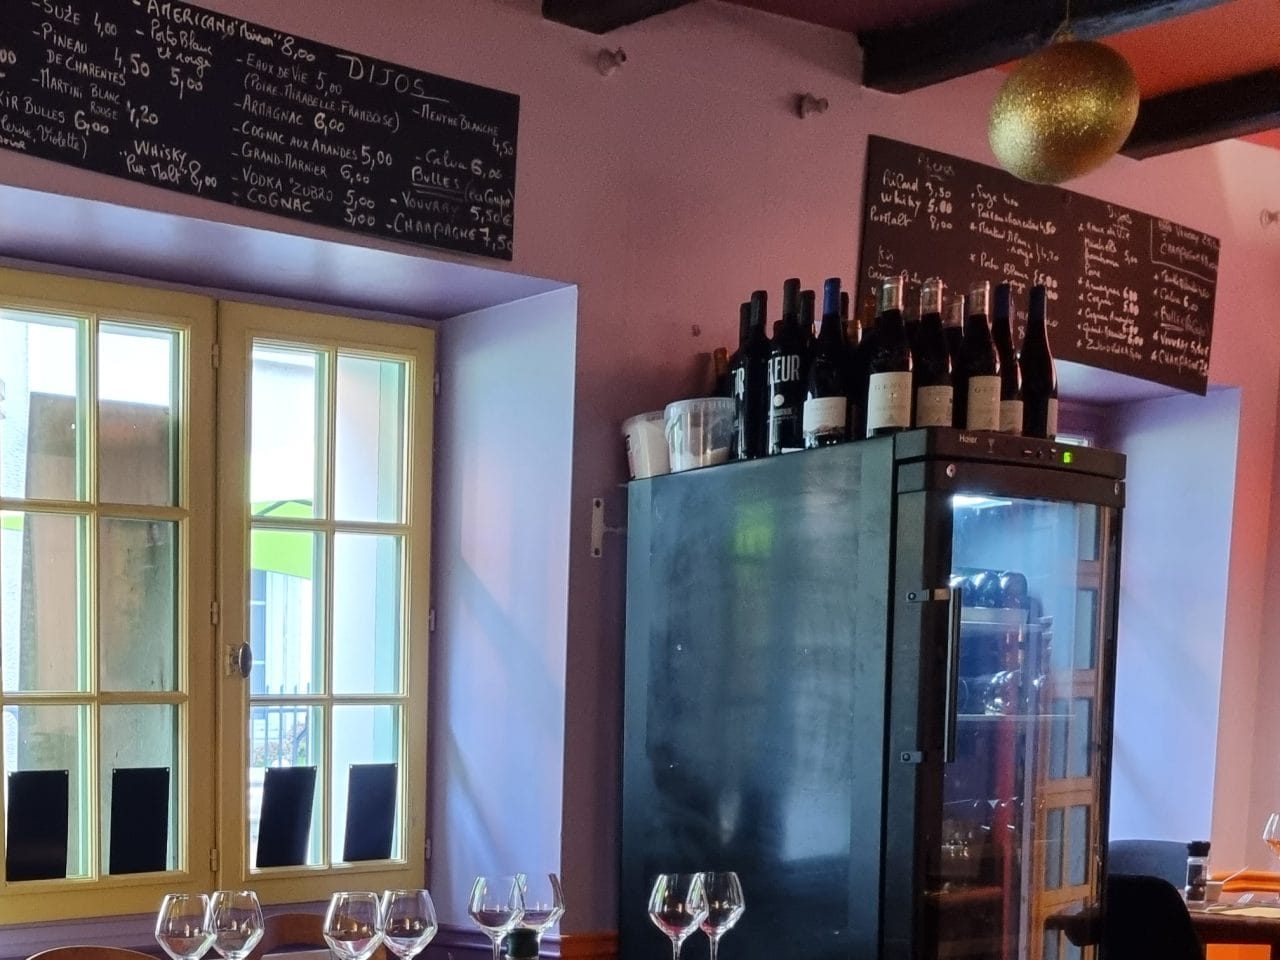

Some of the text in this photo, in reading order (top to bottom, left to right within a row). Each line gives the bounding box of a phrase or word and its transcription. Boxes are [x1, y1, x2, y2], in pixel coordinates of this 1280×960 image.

[280, 36, 316, 63] 8,00
[46, 49, 63, 65] DE
[64, 56, 126, 87] CHARENTES
[169, 65, 203, 100] 5,00
[246, 52, 274, 76] EAUX
[278, 66, 290, 80] DE
[316, 71, 343, 98] 5,00
[90, 82, 121, 106] BLANC
[23, 96, 66, 125] BULLES
[74, 109, 110, 136] 6,00
[242, 94, 345, 136] ARMAGNAC 6,00
[421, 103, 459, 126] MENTHE
[459, 113, 500, 137] BLANCHE
[241, 120, 285, 146] COGNAC
[311, 137, 358, 161] AMANDES
[360, 145, 393, 172] 5,00
[188, 160, 217, 193] 8,00
[242, 164, 375, 210] VODKA 5,00
[339, 164, 370, 185] 6,00
[246, 187, 376, 226] COGNAC 5,00
[394, 211, 478, 240] CHAMPAGNE
